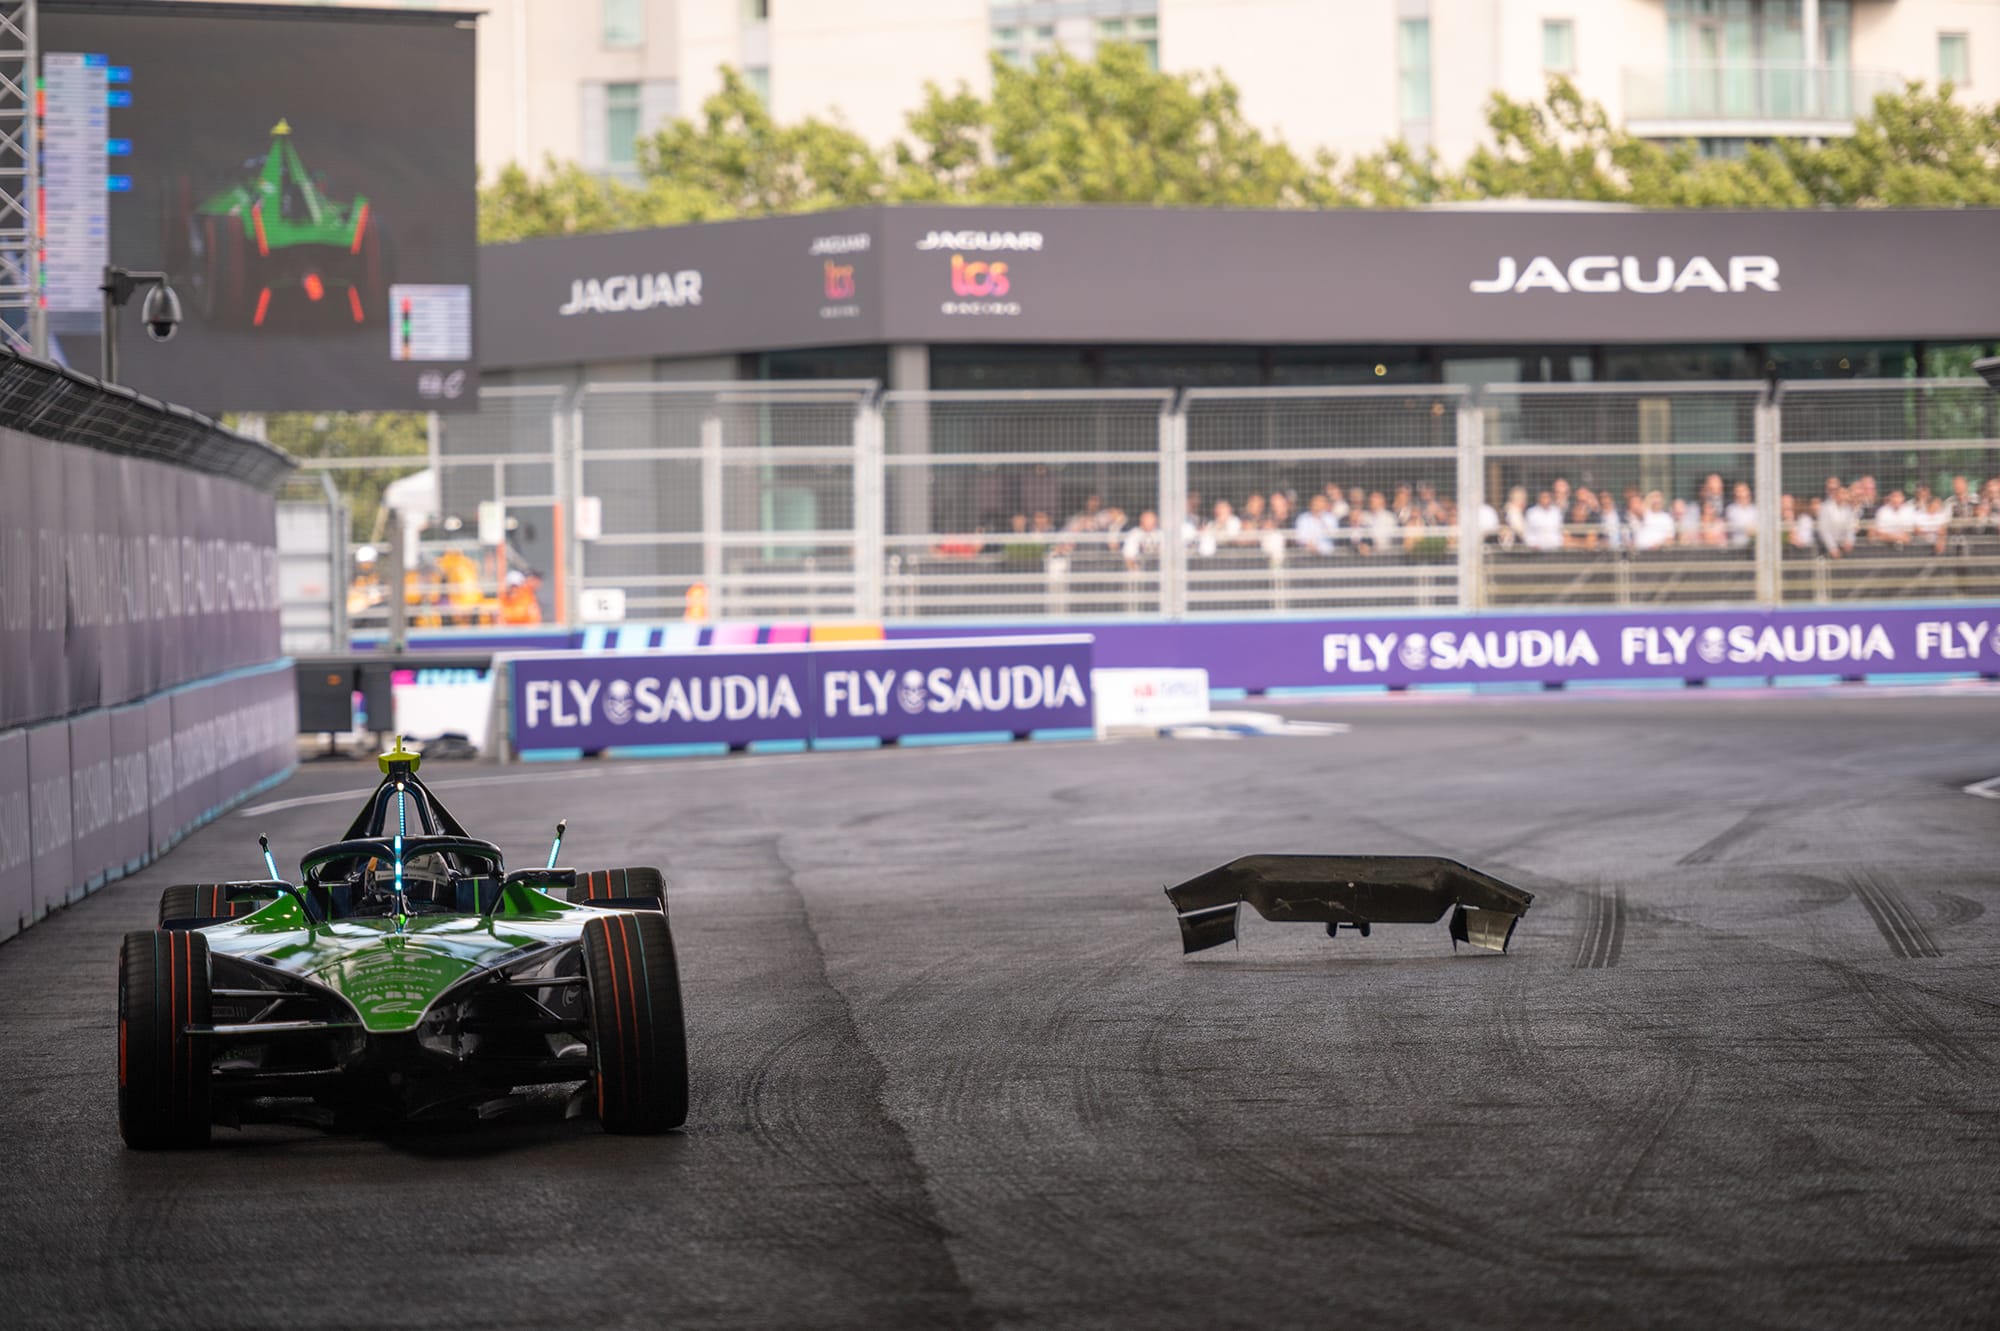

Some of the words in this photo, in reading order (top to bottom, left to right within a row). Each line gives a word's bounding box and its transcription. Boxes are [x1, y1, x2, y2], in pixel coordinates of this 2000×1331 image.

[916, 231, 1044, 250] JAGUAR
[559, 269, 702, 316] JAGUAR
[951, 254, 1010, 296] tcs
[1469, 255, 1780, 294] JAGUAR
[1323, 632, 1398, 673] FLY
[1429, 629, 1599, 670] SAUDIA
[1621, 626, 1695, 666] FLY
[1727, 623, 1895, 663] SAUDIA
[1915, 621, 1993, 661] FLY
[525, 679, 600, 728] FLY
[634, 673, 801, 724] SAUDIA
[824, 669, 896, 717] FLY
[926, 664, 1087, 713] SAUDIA
[347, 964, 442, 979] Algorand
[360, 991, 424, 1004] ABB
